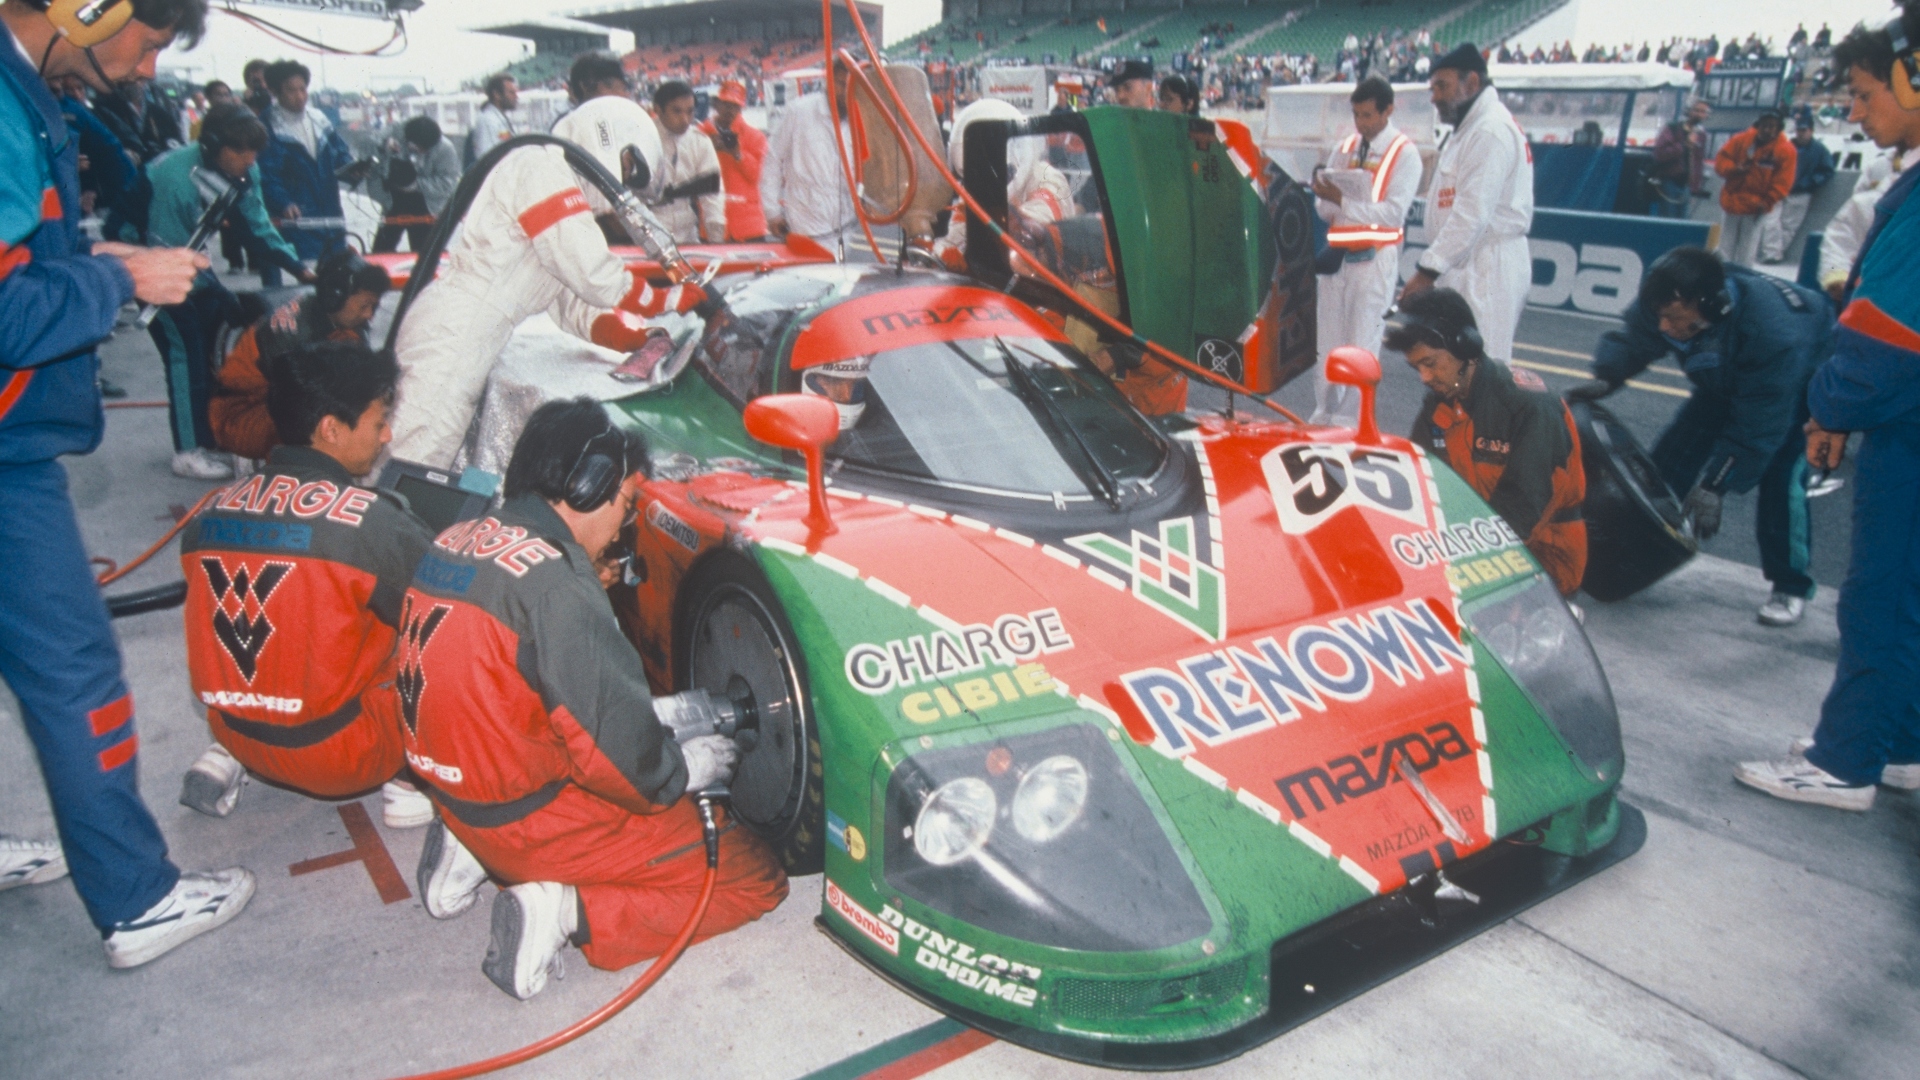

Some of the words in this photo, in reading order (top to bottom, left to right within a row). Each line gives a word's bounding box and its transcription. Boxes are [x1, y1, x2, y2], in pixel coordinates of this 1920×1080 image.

[861, 304, 1022, 336] mazda
[198, 475, 377, 527] HARGE
[1278, 445, 1413, 516] 55
[433, 517, 562, 578] ARGE
[656, 511, 699, 550] IDEMITSU
[1391, 515, 1525, 569] CHARGE
[1444, 549, 1533, 591] CIBIE
[846, 608, 1073, 695] CHARGE
[1121, 599, 1471, 757] RENOWN
[902, 661, 1056, 724] CIBIE
[1274, 720, 1474, 820] mazda
[1366, 823, 1431, 862] MAZDA
[841, 894, 895, 946] brembo
[878, 903, 1042, 980] DUNLOP
